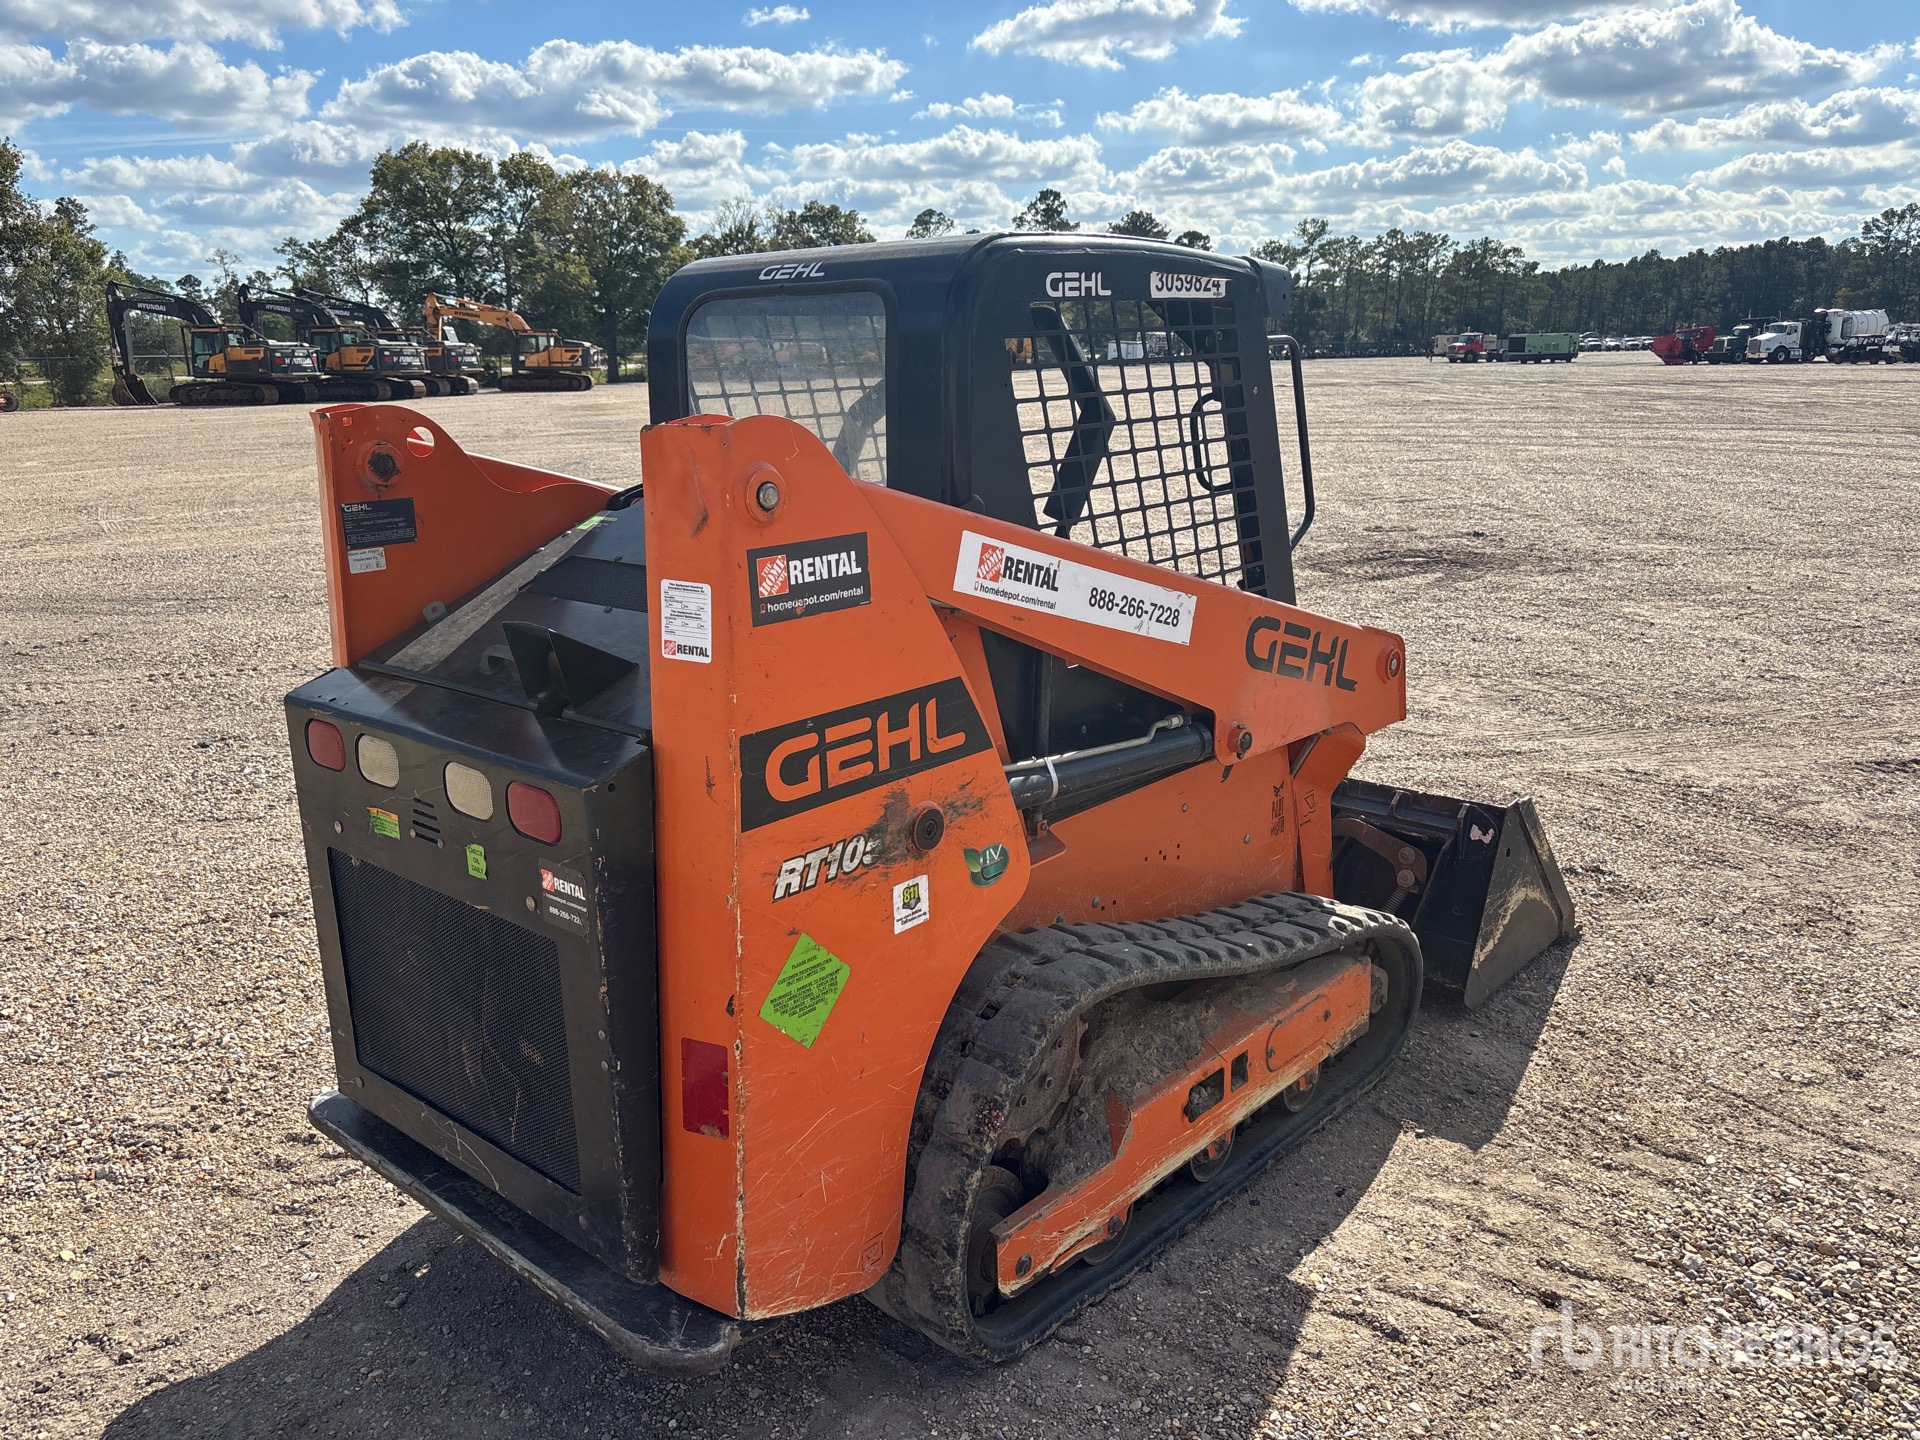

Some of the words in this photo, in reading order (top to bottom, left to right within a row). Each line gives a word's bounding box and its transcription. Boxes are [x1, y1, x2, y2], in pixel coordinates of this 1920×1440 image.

[758, 261, 825, 281] GEHL
[1045, 271, 1112, 298] GEHL
[137, 302, 167, 312] HYUNDAI
[265, 304, 290, 313] HYUNDAI
[453, 310, 481, 319] HYUNDAI
[344, 504, 372, 512] GEHL
[759, 556, 786, 597] HOME
[788, 550, 862, 586] RENTAL
[978, 547, 1002, 579] HOME
[1002, 555, 1059, 592] RENTAL
[767, 585, 864, 613] homedepot.com/rental
[979, 582, 1057, 610] homedepot.com/rental
[1088, 586, 1180, 628] 888-266-7228
[677, 644, 709, 658] RENTAL
[1245, 615, 1358, 692] GEHL
[764, 697, 967, 803] GEHL
[554, 876, 586, 901] RENTAL
[902, 883, 920, 904] 811
